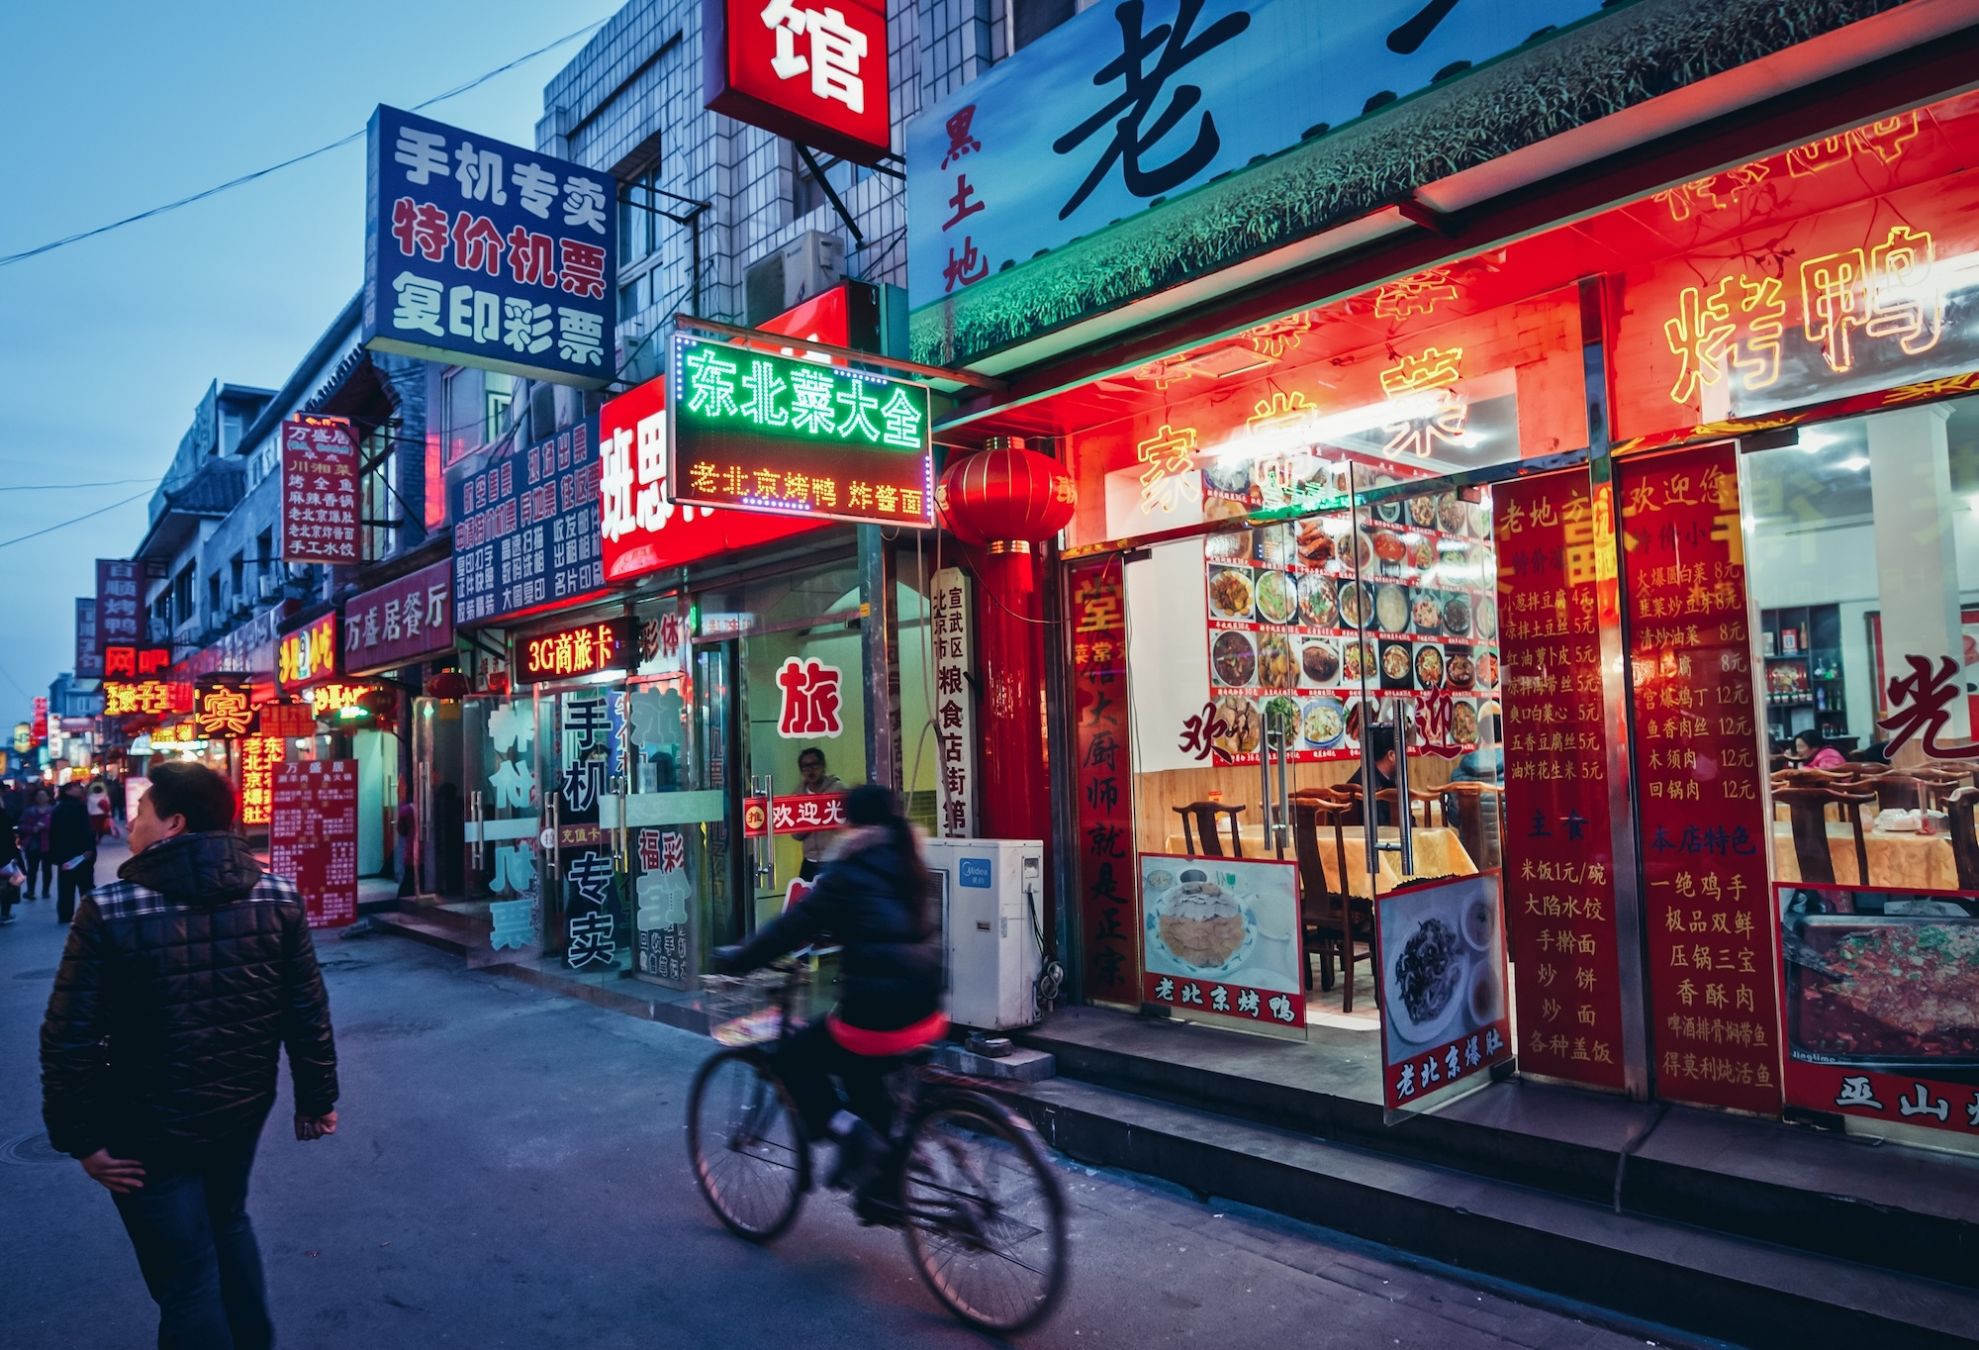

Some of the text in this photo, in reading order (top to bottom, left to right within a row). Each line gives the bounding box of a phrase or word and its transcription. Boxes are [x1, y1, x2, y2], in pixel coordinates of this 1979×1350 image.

[760, 0, 868, 114] 馆
[1052, 0, 1250, 219] 老
[394, 126, 606, 235] 手机专卖
[940, 103, 989, 293] 黑土地
[392, 196, 607, 300] 特价机票
[392, 271, 605, 366] 复印彩票
[1664, 226, 1942, 404] 烤鸭
[687, 349, 922, 449] 东北菜大全
[1138, 347, 1468, 514] 家常菜
[600, 409, 714, 544] 班思
[690, 462, 922, 515] 老北京烤鸭 炸酱面
[1630, 464, 1730, 514] 欢迎您
[288, 491, 354, 509] 麻辣香锅
[1500, 488, 1590, 534] 老地方
[288, 540, 355, 557] 手工水饺
[457, 545, 493, 577] 复印打字
[1714, 560, 1740, 580] 8元
[345, 583, 448, 652] 万盛居餐厅
[1572, 587, 1595, 606] 4元
[934, 589, 948, 660] 北京市
[948, 587, 963, 659] 宣武区
[1574, 615, 1596, 635] 5元
[105, 647, 170, 677] 网吧
[528, 625, 614, 674] 3G商旅卡
[1720, 653, 1748, 673] 8元
[200, 688, 253, 733] 宾
[776, 656, 843, 739] 旅
[1578, 703, 1600, 722] 5元
[1876, 654, 1979, 760] 光
[1178, 701, 1233, 764] 欢
[1415, 685, 1463, 760] 迎
[1579, 732, 1600, 750] 5元
[1646, 716, 1752, 740] 鱼香肉丝 12元
[938, 665, 967, 838] 粮食店街第
[1512, 760, 1604, 781] 油炸花生米 5元
[1649, 747, 1754, 770] 木须肉 12元
[243, 737, 263, 823] 老北京爆肚
[1649, 778, 1756, 801] 回锅肉 12元
[562, 827, 601, 844] 充值卡
[563, 697, 615, 969] 手机专卖
[772, 799, 847, 829] 欢迎光
[1528, 808, 1589, 841] 主食
[638, 828, 684, 874] 福彩
[1651, 824, 1757, 857] 本店特色
[1521, 857, 1607, 886] 米饭1元/碗
[1651, 871, 1748, 902] 一绝鸡手
[1524, 893, 1606, 921] 大陷水饺
[1665, 905, 1755, 941] 极品双鲜
[1536, 928, 1596, 957] 手擀面
[1670, 944, 1756, 974] 压锅三宝
[1155, 976, 1296, 1023] 老北京烤鸭
[1676, 978, 1754, 1013] 香酥肉
[1396, 1027, 1504, 1100] 老北京爆肚
[1529, 1029, 1615, 1065] 各种盖饭
[1663, 1051, 1774, 1089] 得莫利炖活鱼
